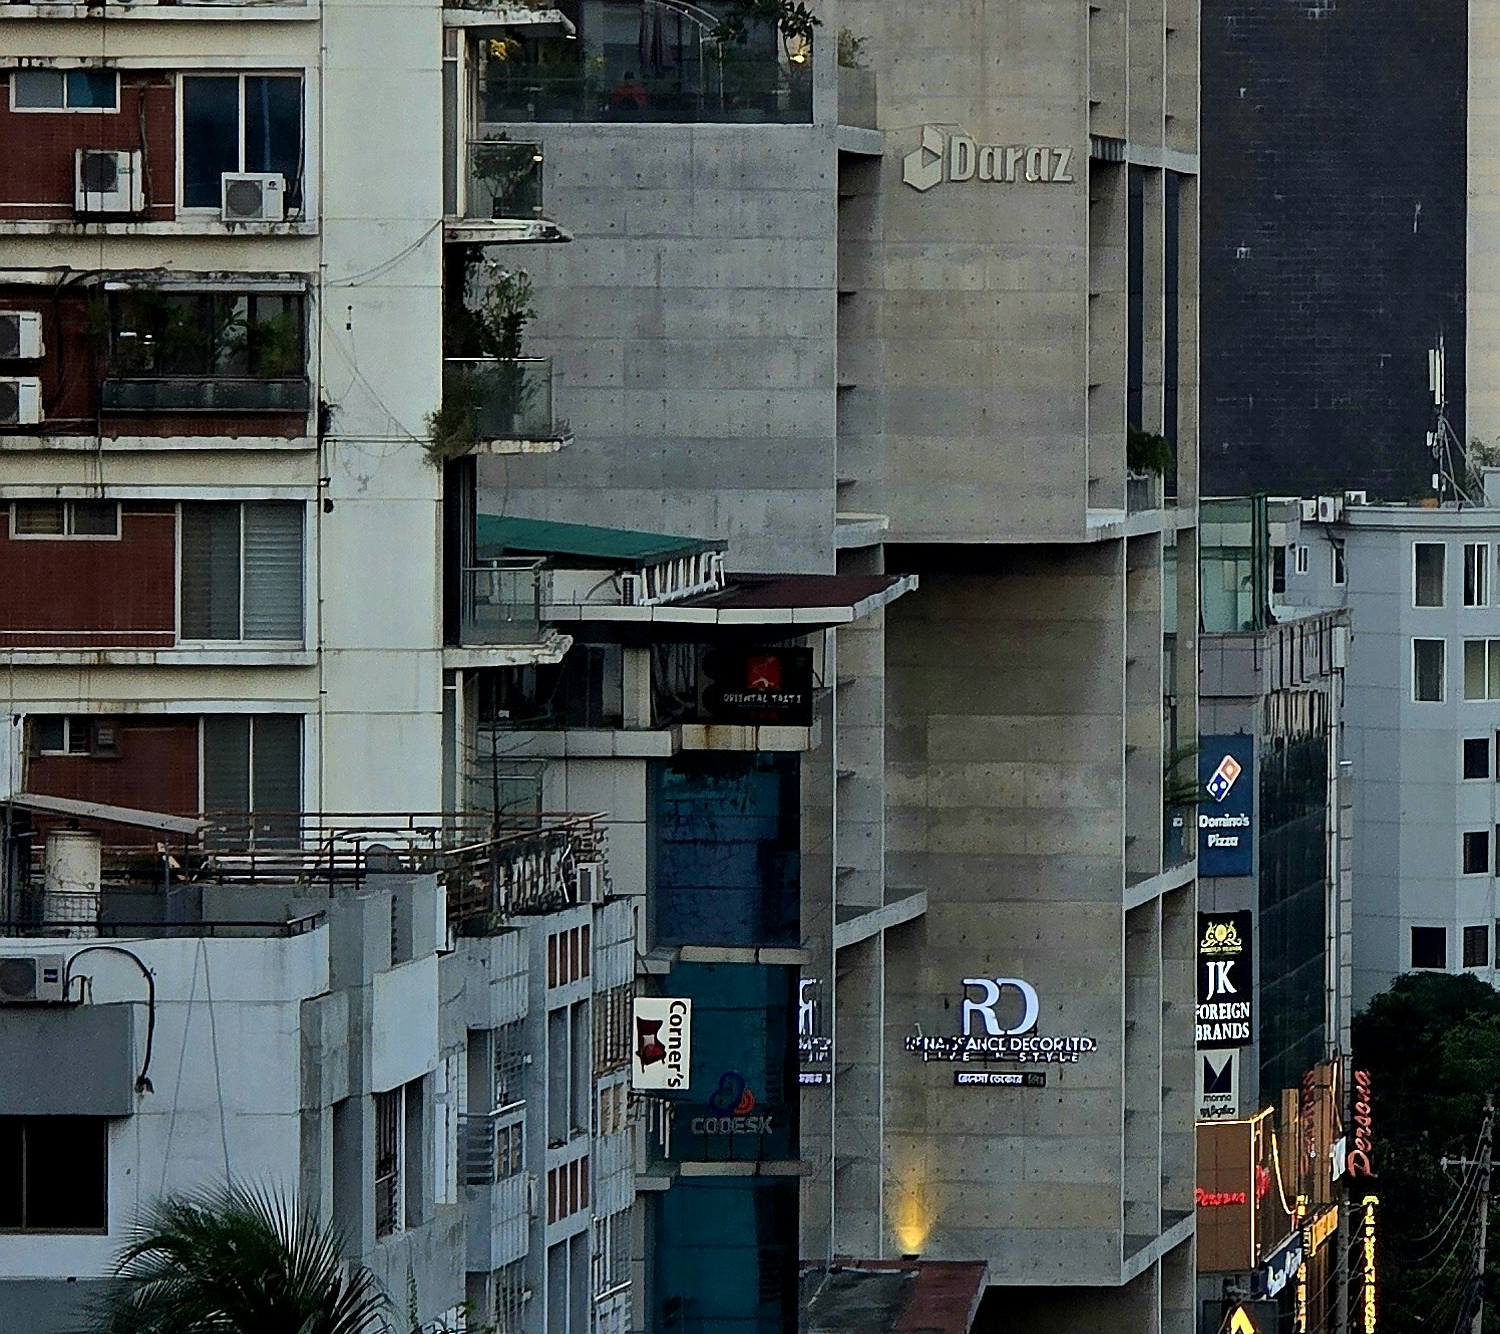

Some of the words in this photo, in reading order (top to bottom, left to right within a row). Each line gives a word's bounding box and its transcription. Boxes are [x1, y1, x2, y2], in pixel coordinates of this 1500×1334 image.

[950, 135, 1073, 182] Daraz
[1199, 813, 1250, 828] Domino's
[1208, 833, 1239, 847] Pizza
[1206, 960, 1237, 1001] JK
[962, 978, 1039, 1036] RD
[667, 1000, 687, 1088] Corner's
[1196, 1022, 1250, 1041] BRANDS
[1019, 1052, 1080, 1063] STYLE
